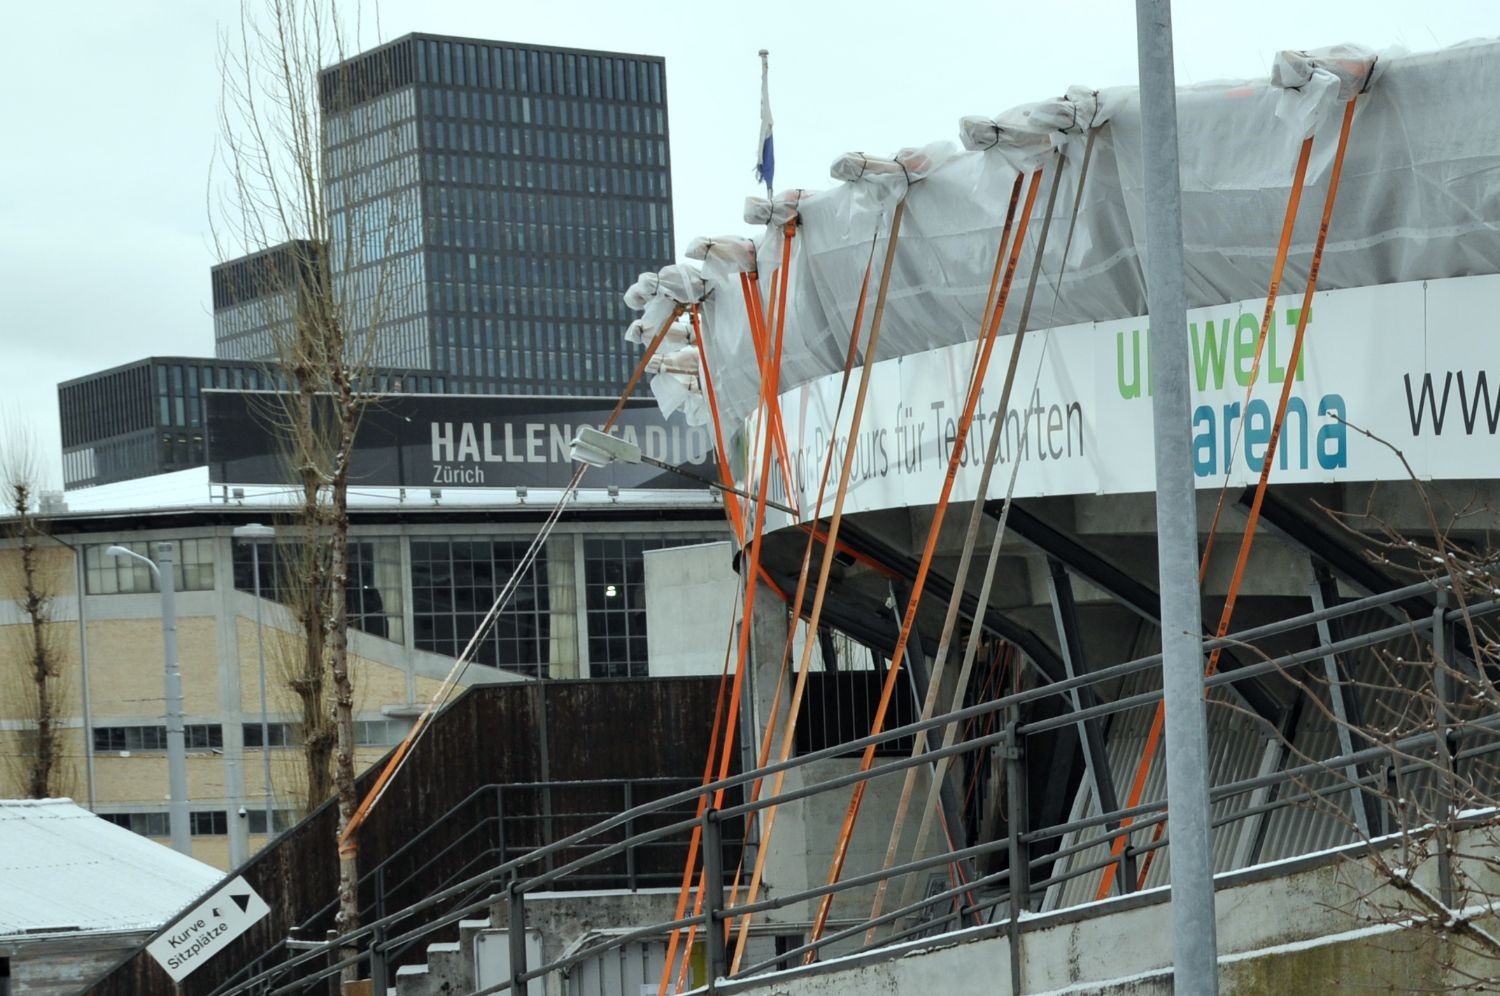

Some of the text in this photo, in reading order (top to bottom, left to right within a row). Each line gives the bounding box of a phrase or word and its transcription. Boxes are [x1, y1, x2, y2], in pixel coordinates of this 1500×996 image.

[895, 401, 925, 475] für
[1193, 393, 1347, 478] arena
[432, 464, 485, 484] Zürich
[167, 919, 206, 948] Kurve
[167, 922, 228, 970] Sitzplätze
